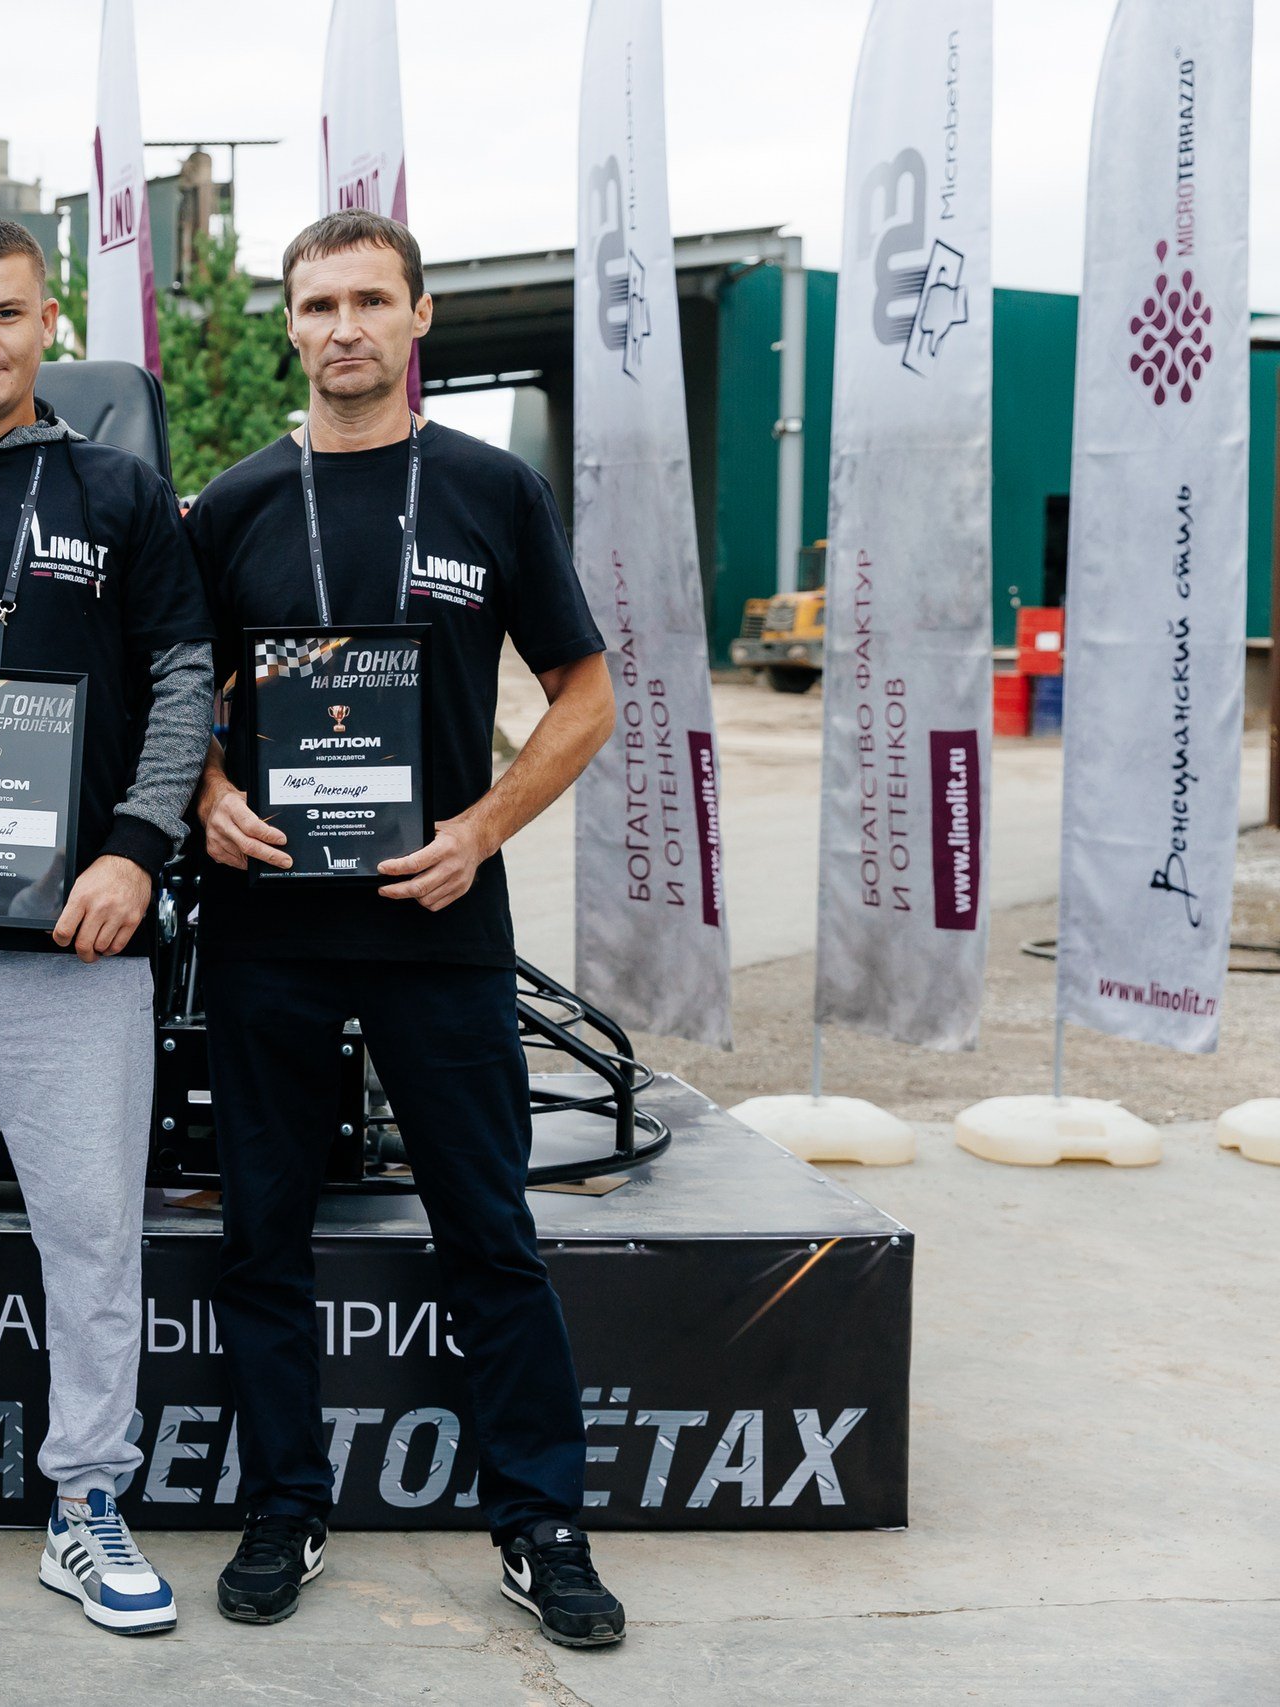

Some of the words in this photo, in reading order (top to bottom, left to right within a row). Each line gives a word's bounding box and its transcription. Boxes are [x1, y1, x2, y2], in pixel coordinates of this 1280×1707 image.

[941, 29, 960, 221] Microbeton
[1177, 59, 1195, 258] MICROTERRAZZO
[30, 561, 57, 570] ADVANCED
[58, 564, 82, 574] CONCRETE
[84, 568, 106, 581] TREAENT
[54, 572, 88, 584] TECHNOLOGIES
[398, 515, 486, 591] LINOLIT
[410, 580, 435, 589] DVANCED
[436, 583, 461, 595] CONCRETE
[432, 591, 467, 606] TECHNOLOGIES
[612, 549, 639, 688] ФАКТУР
[856, 549, 873, 689] ФАКТУР
[311, 676, 330, 688] НА
[332, 671, 419, 688] ВЕРТОЛЁТАХ
[344, 650, 418, 672] ГОНКИ
[0, 694, 74, 719] ГОНКИ
[1150, 616, 1202, 929] Венецианский
[1176, 484, 1193, 600] стиль
[300, 736, 381, 750] ДИПЛОМ
[316, 754, 366, 762] награждается
[648, 678, 683, 867] ОТТЕНКОВ
[885, 677, 911, 871] ОТТЕНКОВ
[306, 809, 320, 819] 3
[624, 700, 652, 902] БОГАТСТВО
[857, 703, 880, 906] БОГАТСТВО
[946, 747, 972, 914] www.linolit.ru
[667, 881, 685, 907] И
[894, 886, 911, 911] И
[115, 1387, 868, 1508] ЕТОЁТАХ
